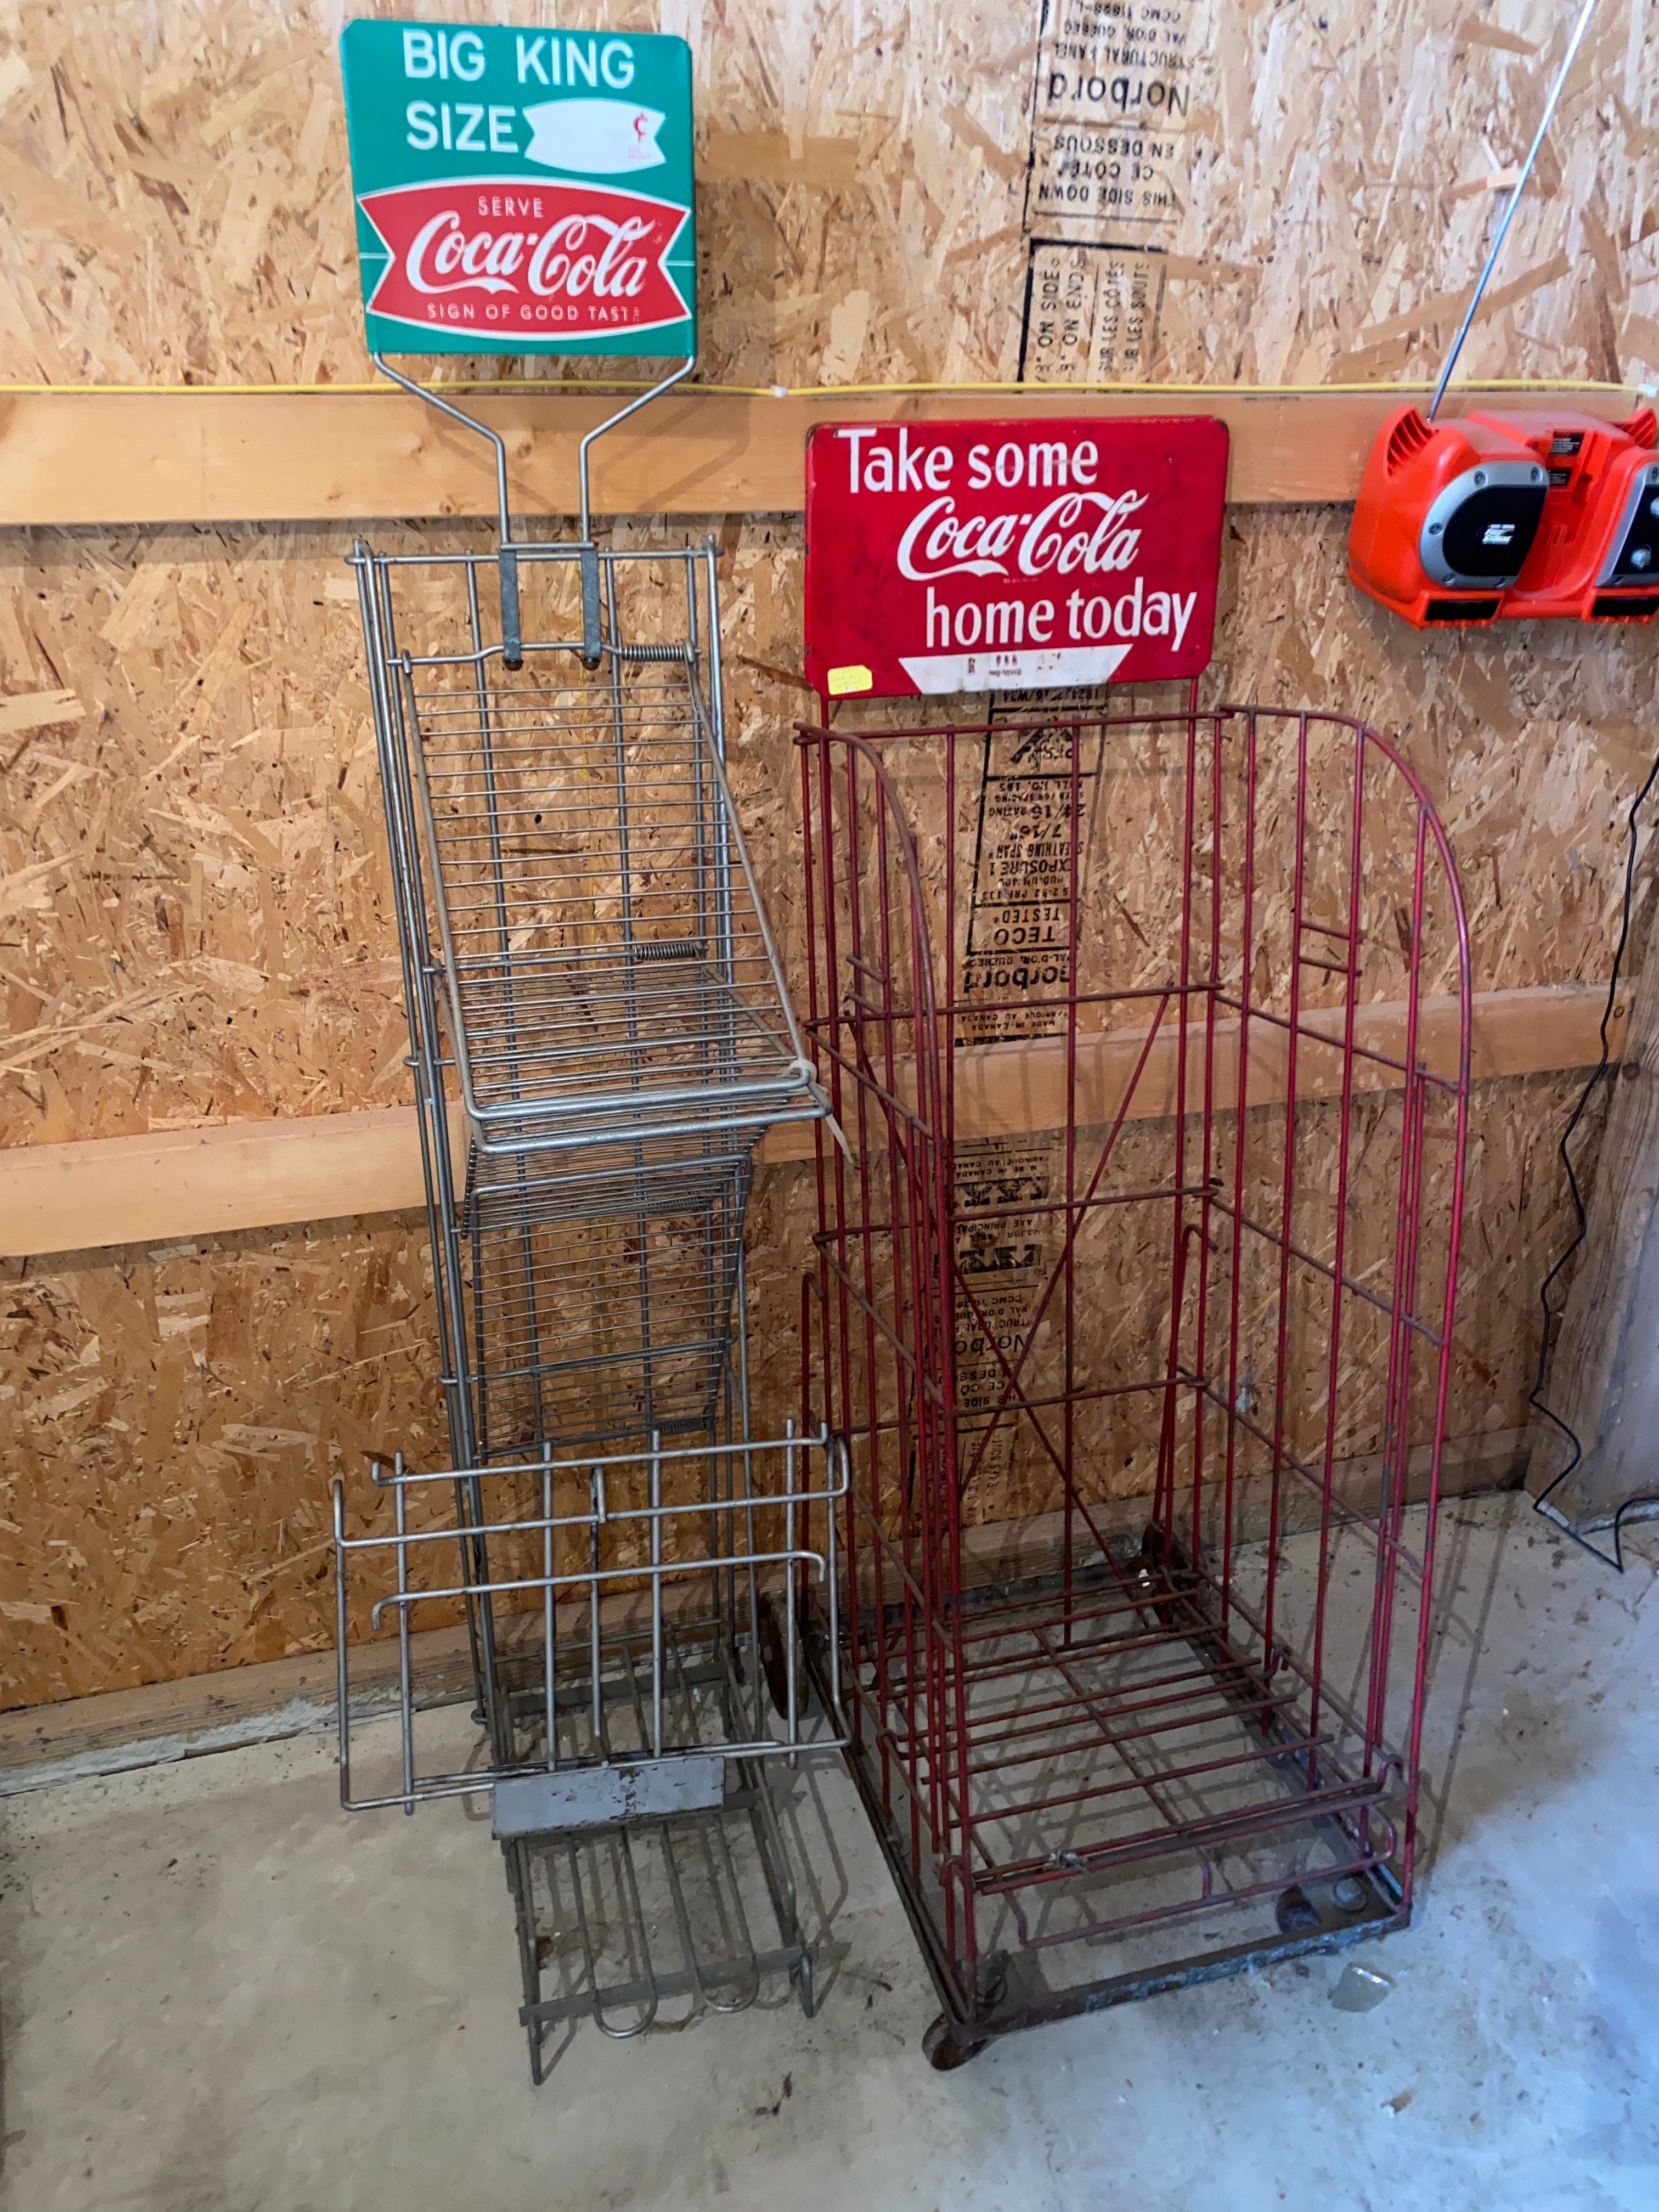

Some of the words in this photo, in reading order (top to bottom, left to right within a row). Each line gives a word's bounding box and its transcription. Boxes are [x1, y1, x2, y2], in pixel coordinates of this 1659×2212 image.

[403, 28, 486, 81] BIG
[516, 34, 635, 89] KING
[1048, 72, 1189, 117] Norbord
[406, 100, 518, 153] SIZE
[1039, 184, 1089, 204] DOWN
[478, 196, 544, 218] SERVE
[406, 211, 656, 297] Coca-Cola
[427, 302, 475, 319] SIGN
[486, 303, 511, 320] OF
[521, 304, 578, 320] GOOD
[588, 306, 640, 322] TASTE
[837, 427, 953, 494] Take
[968, 440, 1098, 489] some
[897, 489, 1149, 581] Coca-Cola
[927, 586, 1055, 648] home
[1066, 576, 1198, 652] today
[988, 806, 1026, 819] RATING
[1027, 842, 1084, 857] SEATHING
[989, 862, 996, 876] 1
[1002, 907, 1060, 924] TESTED
[994, 926, 1055, 945] TECO
[956, 1169, 992, 1177] CANADA
[956, 1221, 1006, 1233] PRINCIPAL
[988, 1381, 1005, 1390] CE
[964, 1396, 990, 1407] SIDE
